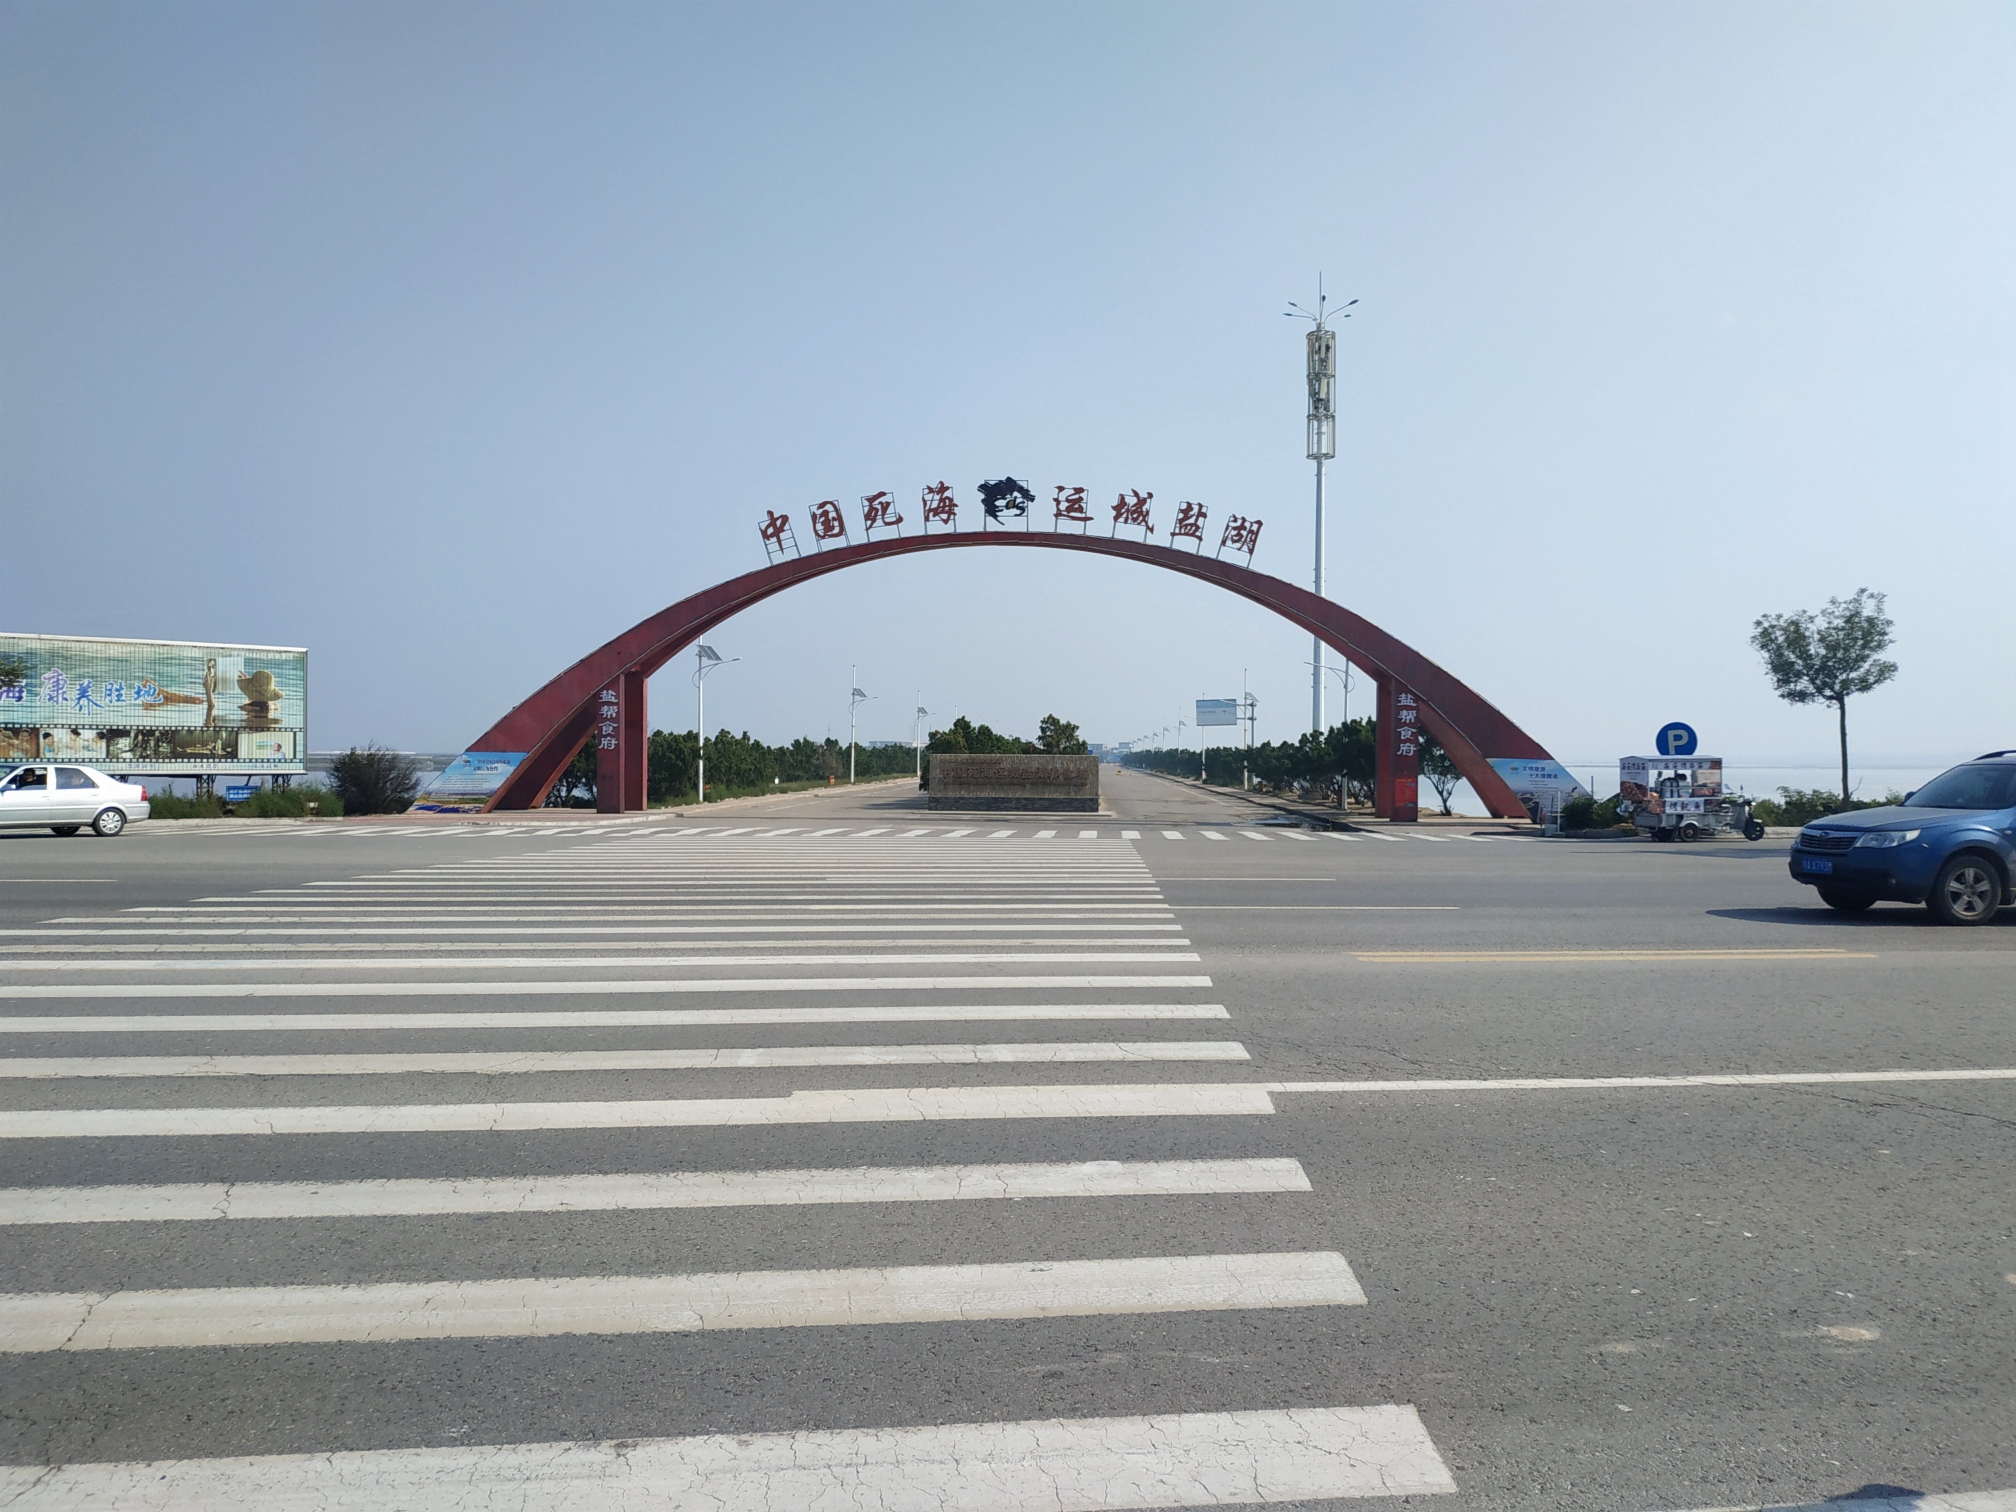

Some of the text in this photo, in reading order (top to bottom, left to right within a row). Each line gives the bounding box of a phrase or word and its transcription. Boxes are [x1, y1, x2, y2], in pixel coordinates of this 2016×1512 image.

[760, 480, 958, 555] 中国死海
[1053, 485, 1264, 556] 运城盐湖
[598, 690, 618, 750] 盐帮食府
[1396, 693, 1417, 757] 盐帮食府
[1667, 729, 1689, 754] P
